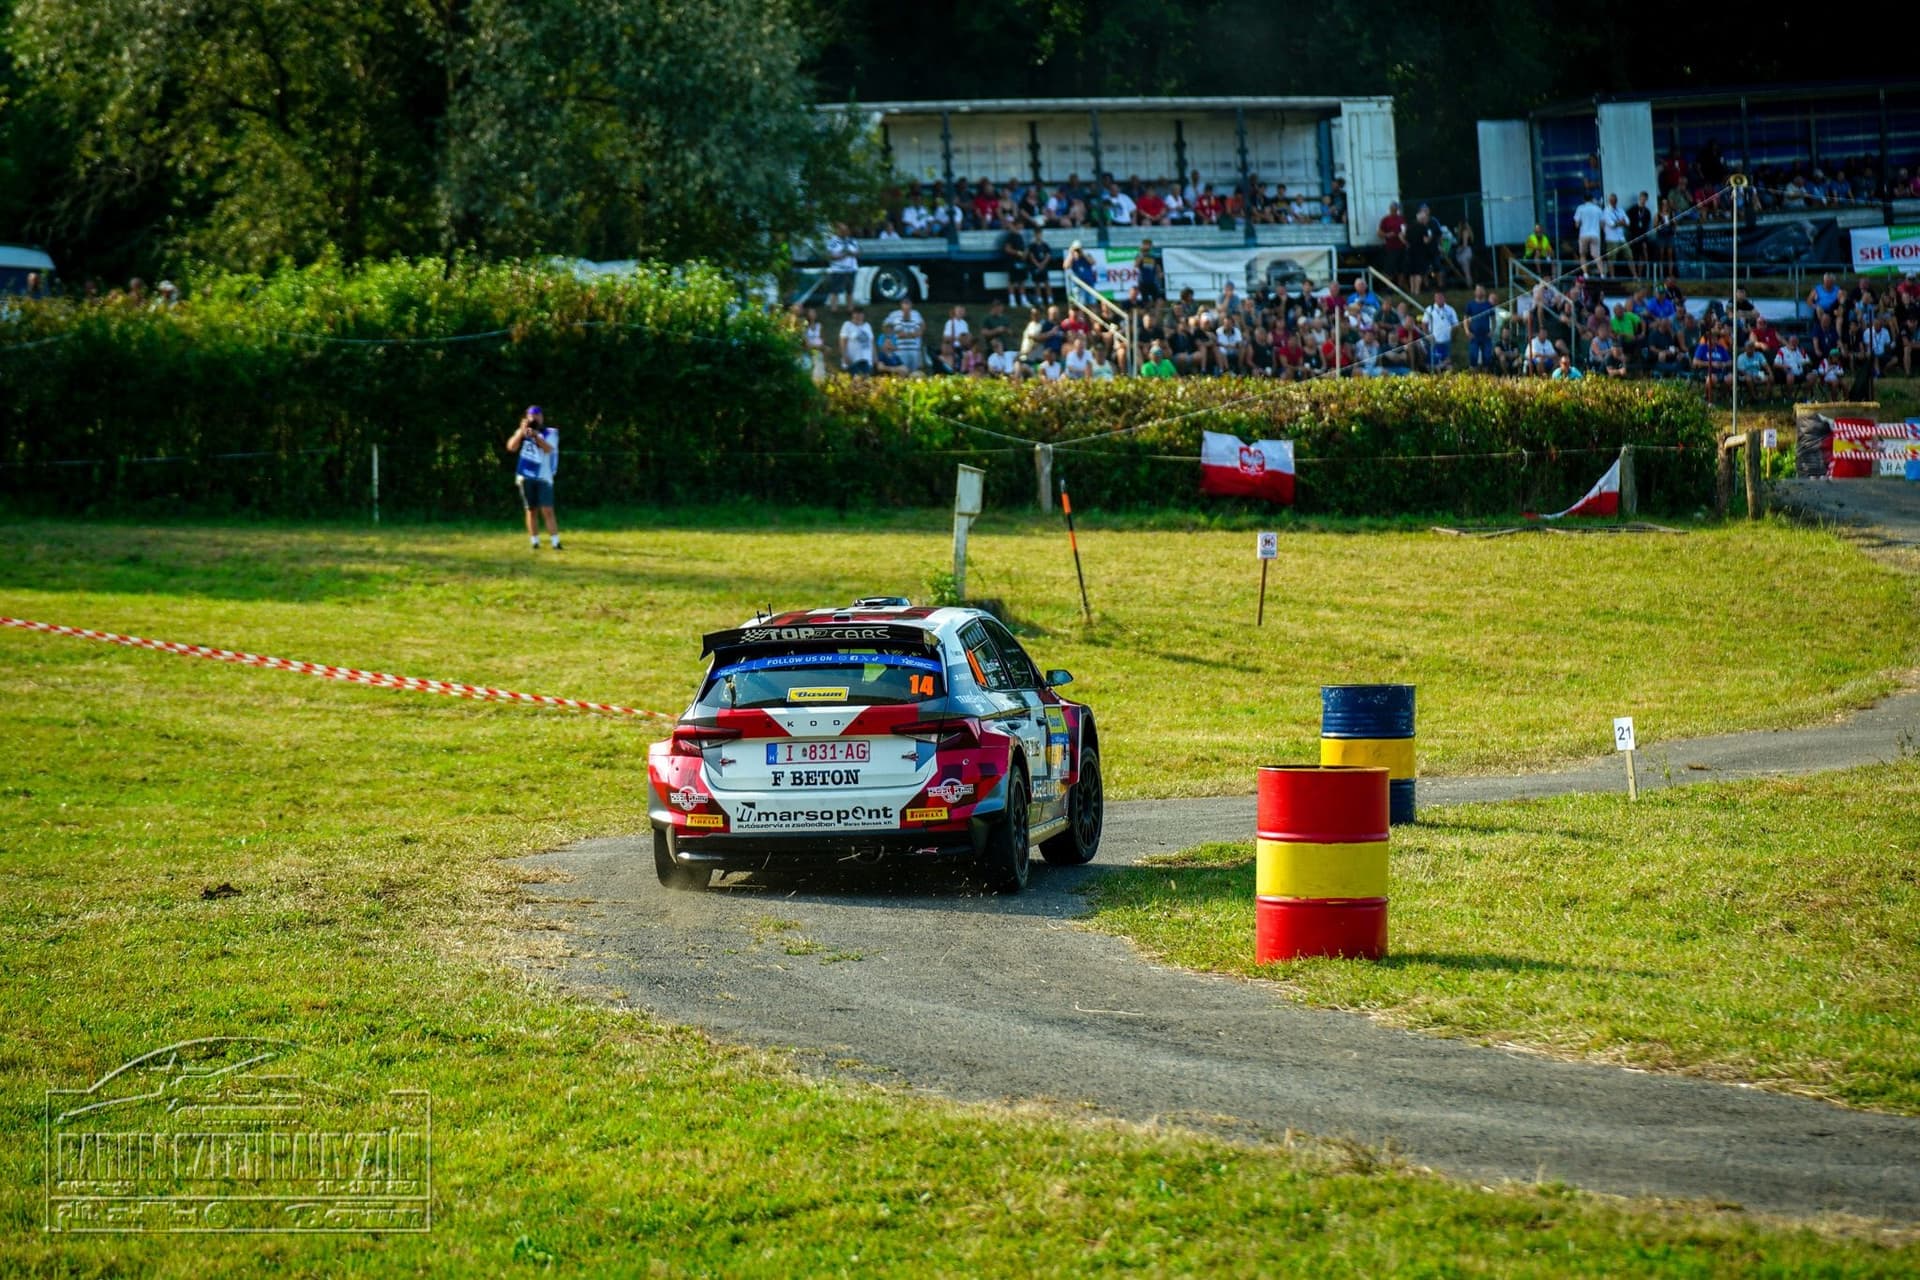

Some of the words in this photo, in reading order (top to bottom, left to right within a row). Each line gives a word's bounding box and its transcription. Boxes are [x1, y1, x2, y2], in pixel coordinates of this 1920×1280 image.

[831, 629, 891, 640] CARS
[767, 656, 802, 666] FOLLOW
[909, 674, 934, 696] 14
[1616, 726, 1632, 741] 21
[772, 771, 784, 786] F
[790, 769, 860, 786] BETON
[910, 809, 943, 818] PIRELLI
